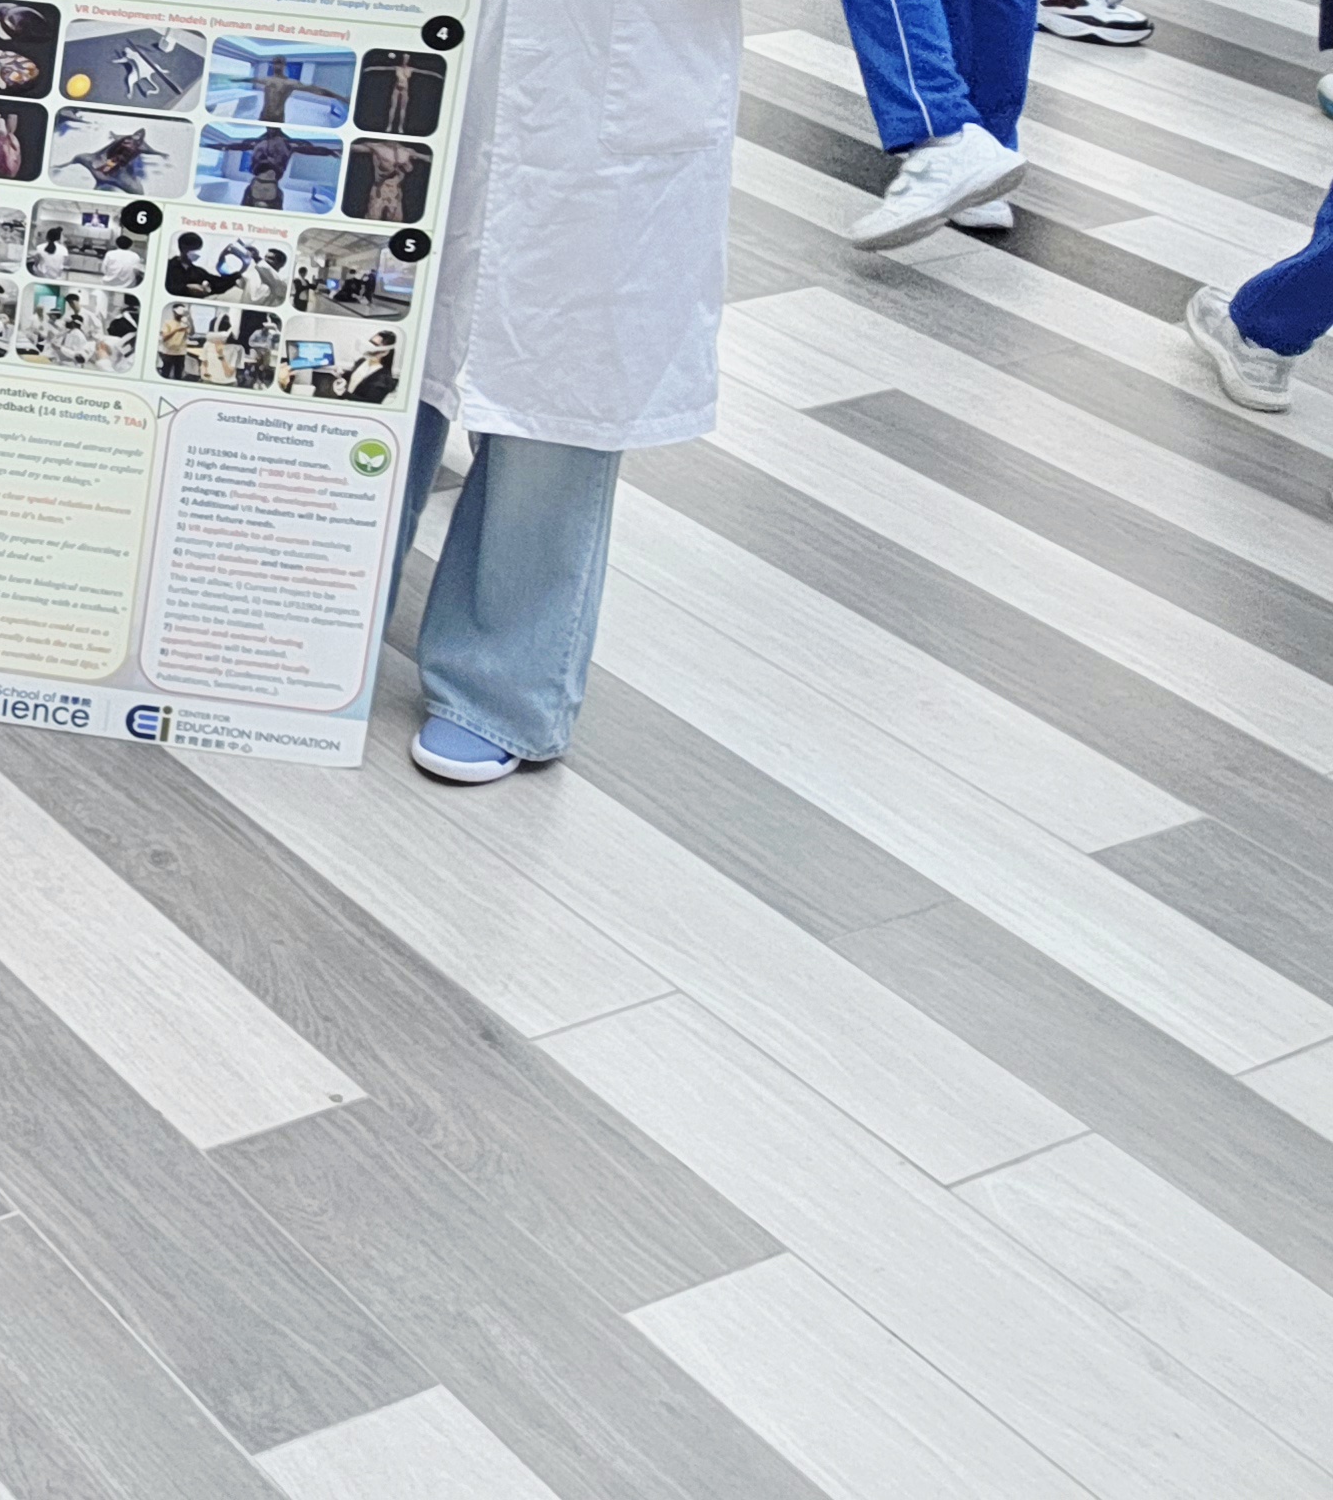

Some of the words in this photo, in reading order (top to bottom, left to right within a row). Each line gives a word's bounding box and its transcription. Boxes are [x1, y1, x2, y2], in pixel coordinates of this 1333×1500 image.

[74, 3, 89, 20] VR
[89, 5, 164, 21] Development:
[167, 13, 207, 29] Models
[209, 16, 252, 29] (Human
[254, 22, 275, 32] and
[277, 23, 295, 34] Rat
[297, 26, 350, 41] Anatomy)
[436, 27, 449, 41] 4
[136, 211, 147, 225] 6
[180, 216, 216, 230] Testing
[219, 220, 228, 229] &
[231, 221, 244, 231] TA
[247, 223, 288, 238] Training
[404, 239, 416, 253] 5
[40, 390, 72, 404] Focus
[75, 395, 110, 410] Group
[112, 399, 122, 410] &
[37, 405, 56, 416] (14
[59, 409, 110, 425] students,
[217, 411, 293, 431] Sustainability
[295, 423, 318, 432] and
[320, 423, 359, 438] Future
[256, 431, 313, 447] Directions
[42, 692, 57, 703] of
[178, 709, 212, 722] CENTER
[212, 711, 230, 724] FOR
[176, 720, 251, 739] EDUCATION
[254, 731, 339, 750] INNOVATION
